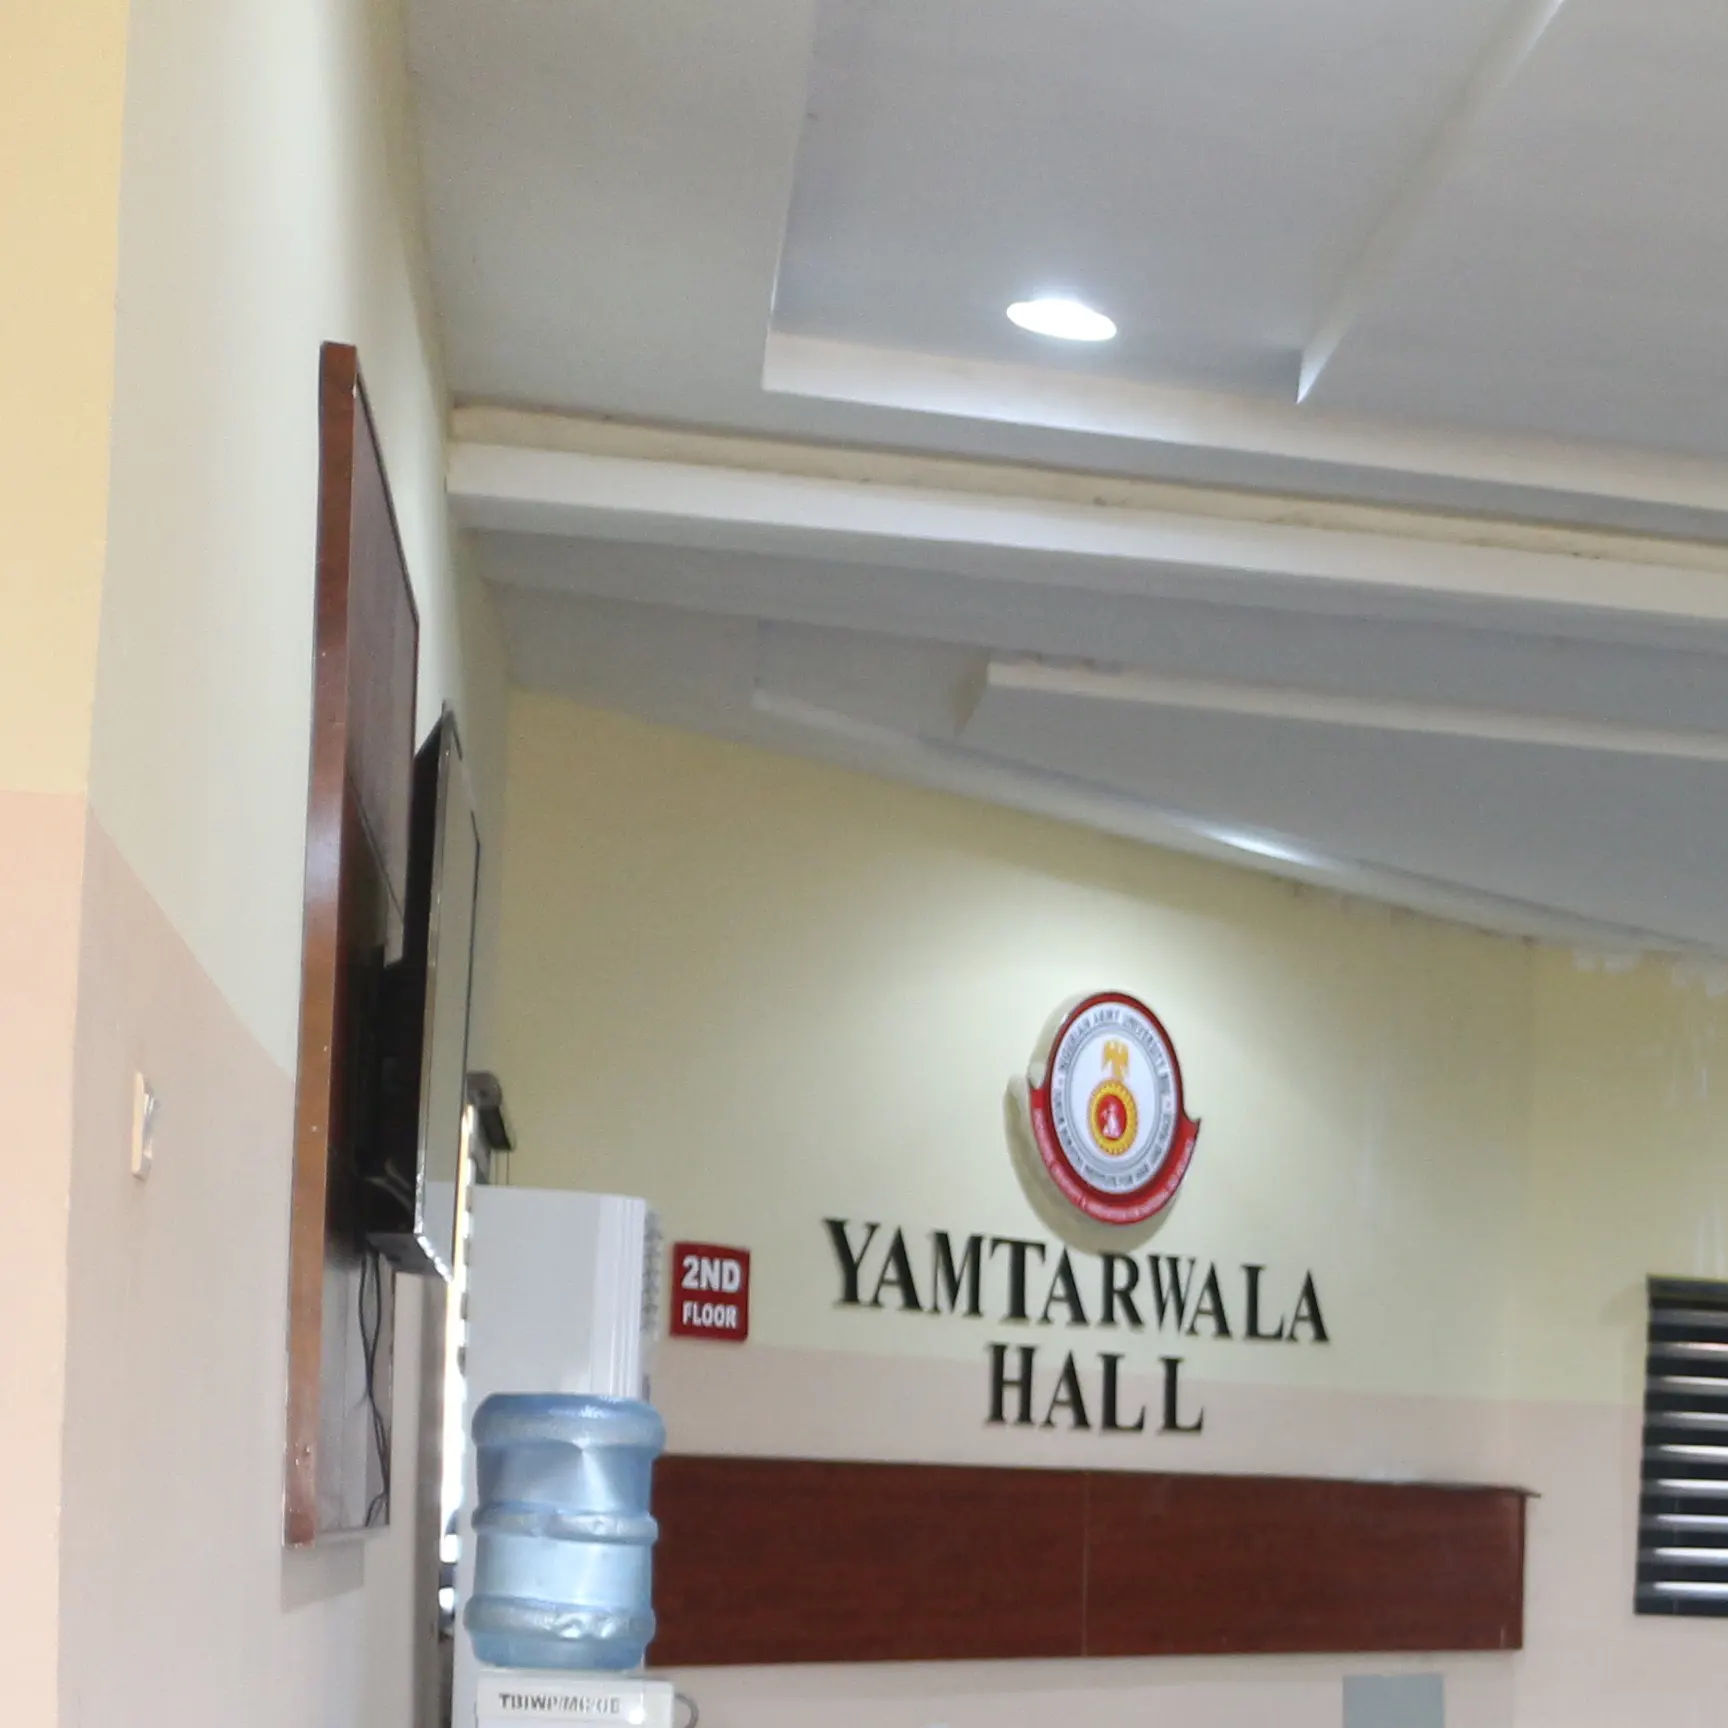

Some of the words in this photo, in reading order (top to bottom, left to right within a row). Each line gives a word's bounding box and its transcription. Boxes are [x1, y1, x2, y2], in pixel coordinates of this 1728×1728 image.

[681, 1254, 741, 1293] 2ND
[823, 1218, 1330, 1343] YAMTARWALA
[682, 1300, 736, 1329] FLOOR
[984, 1343, 1204, 1432] HALL
